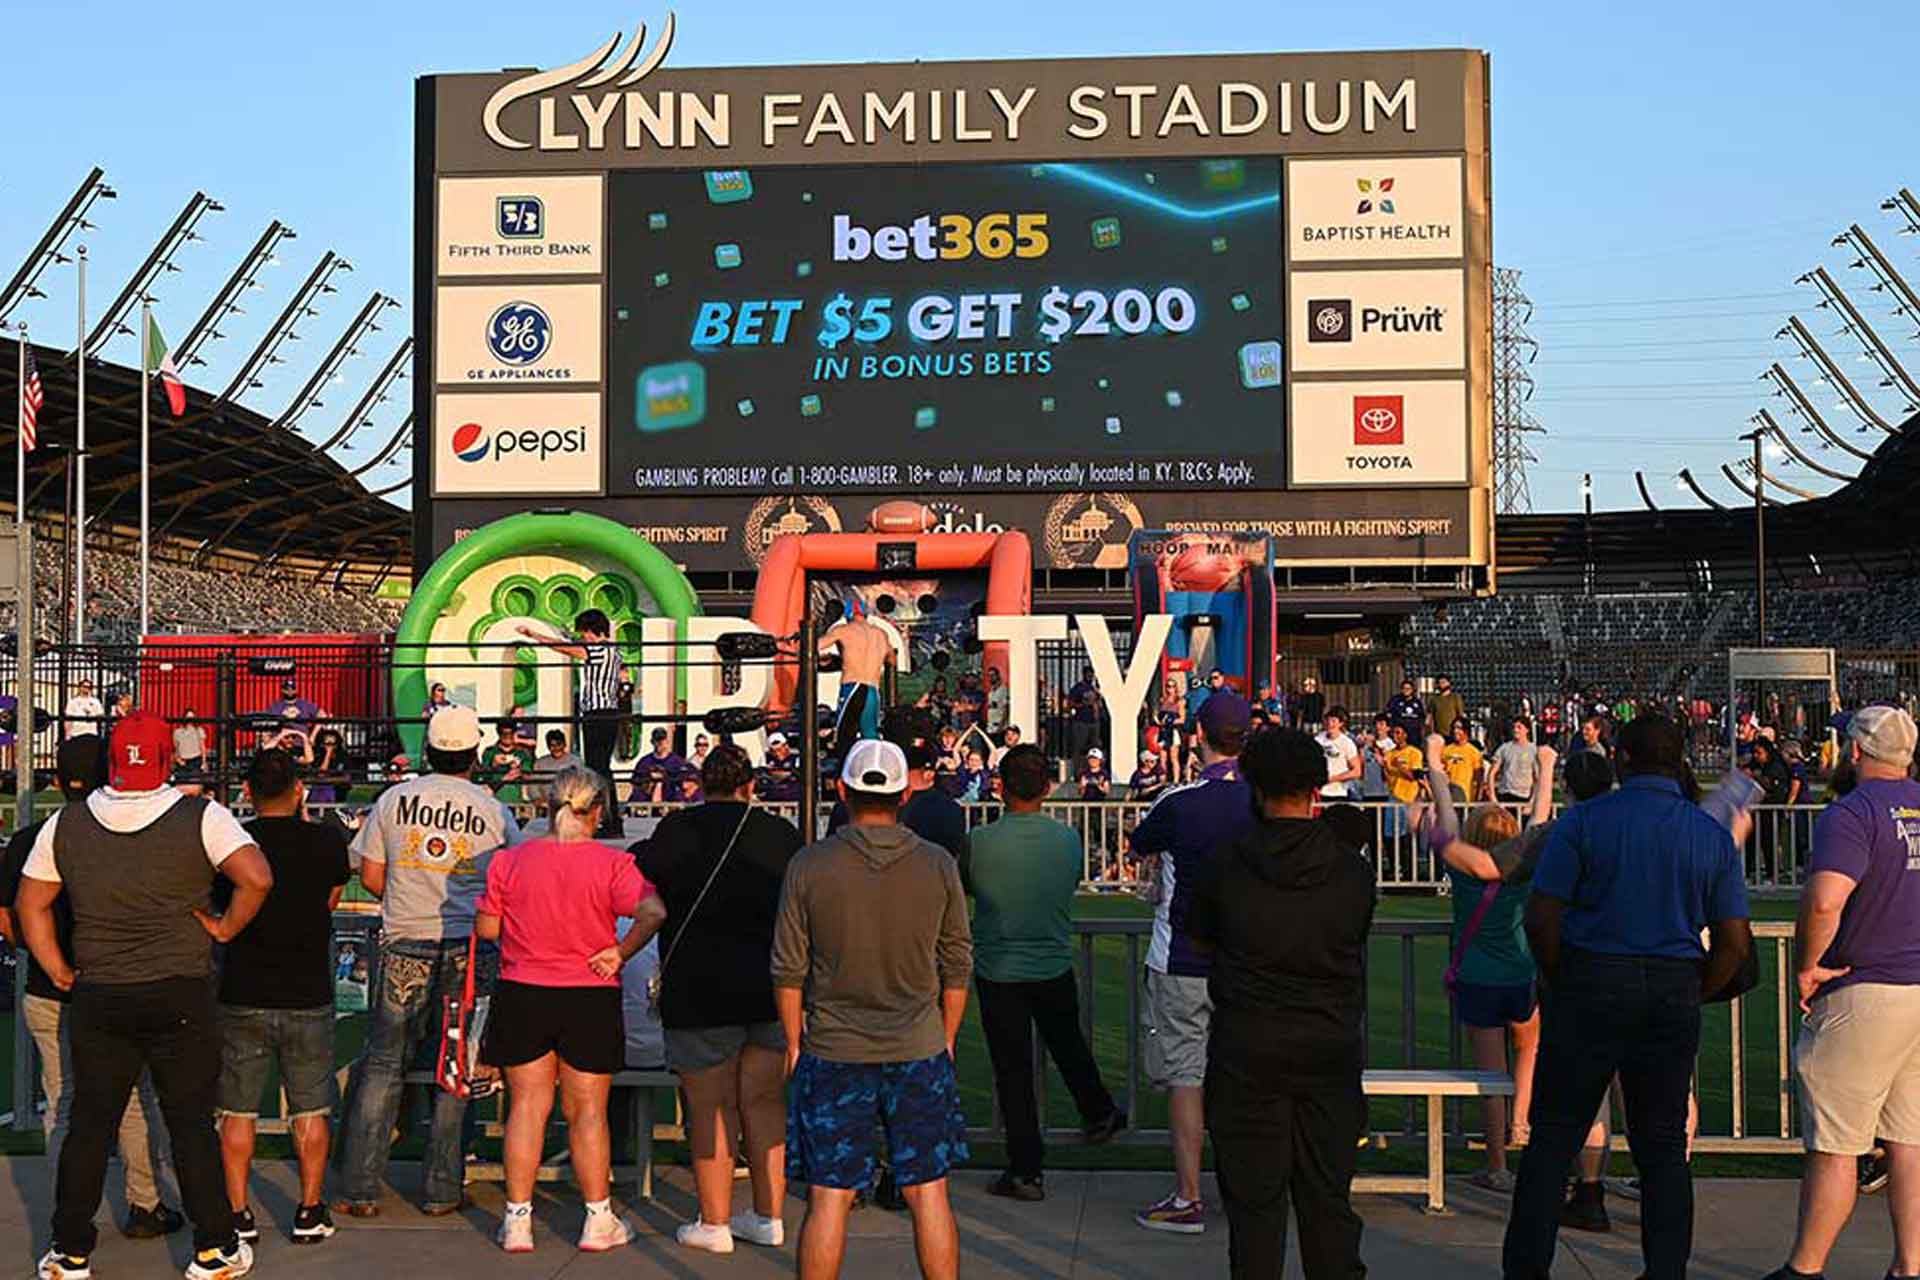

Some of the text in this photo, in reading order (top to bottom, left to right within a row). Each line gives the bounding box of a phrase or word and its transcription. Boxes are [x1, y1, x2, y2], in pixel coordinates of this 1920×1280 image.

[538, 78, 1417, 151] LYNN FAMILY STADIUM
[833, 213, 1049, 261] bet365
[1303, 225, 1450, 241] BAPTIST HEALTH
[448, 243, 591, 257] FIFTH THIRD BANK
[690, 286, 1196, 349] BET $5 GET $200
[1362, 306, 1443, 332] Prüvit
[467, 368, 571, 380] GE APPLIANCES
[813, 350, 1052, 380] IN BONUS BETS
[495, 425, 586, 461] pepsi
[636, 467, 698, 487] GAMBLING
[703, 467, 767, 487] PROBLEM?
[771, 465, 792, 486] Call
[907, 465, 933, 485] 18+
[939, 465, 967, 487] only.
[971, 464, 1002, 484] Must
[1006, 464, 1022, 483] be
[1026, 463, 1085, 487] physically
[1089, 463, 1133, 482] located
[1139, 462, 1150, 481] in
[1155, 463, 1174, 481] KY.
[1217, 461, 1255, 484] Apply.
[1345, 456, 1413, 469] TOYOTA
[687, 526, 729, 543] SPIRIT
[1250, 520, 1294, 536] THOSE
[1296, 520, 1331, 536] WITH
[1332, 520, 1342, 535] A
[1344, 519, 1407, 535] FIGHTING
[1408, 519, 1451, 535] SPIRIT
[1140, 543, 1189, 554] HOOP
[396, 795, 486, 836] Modelo
